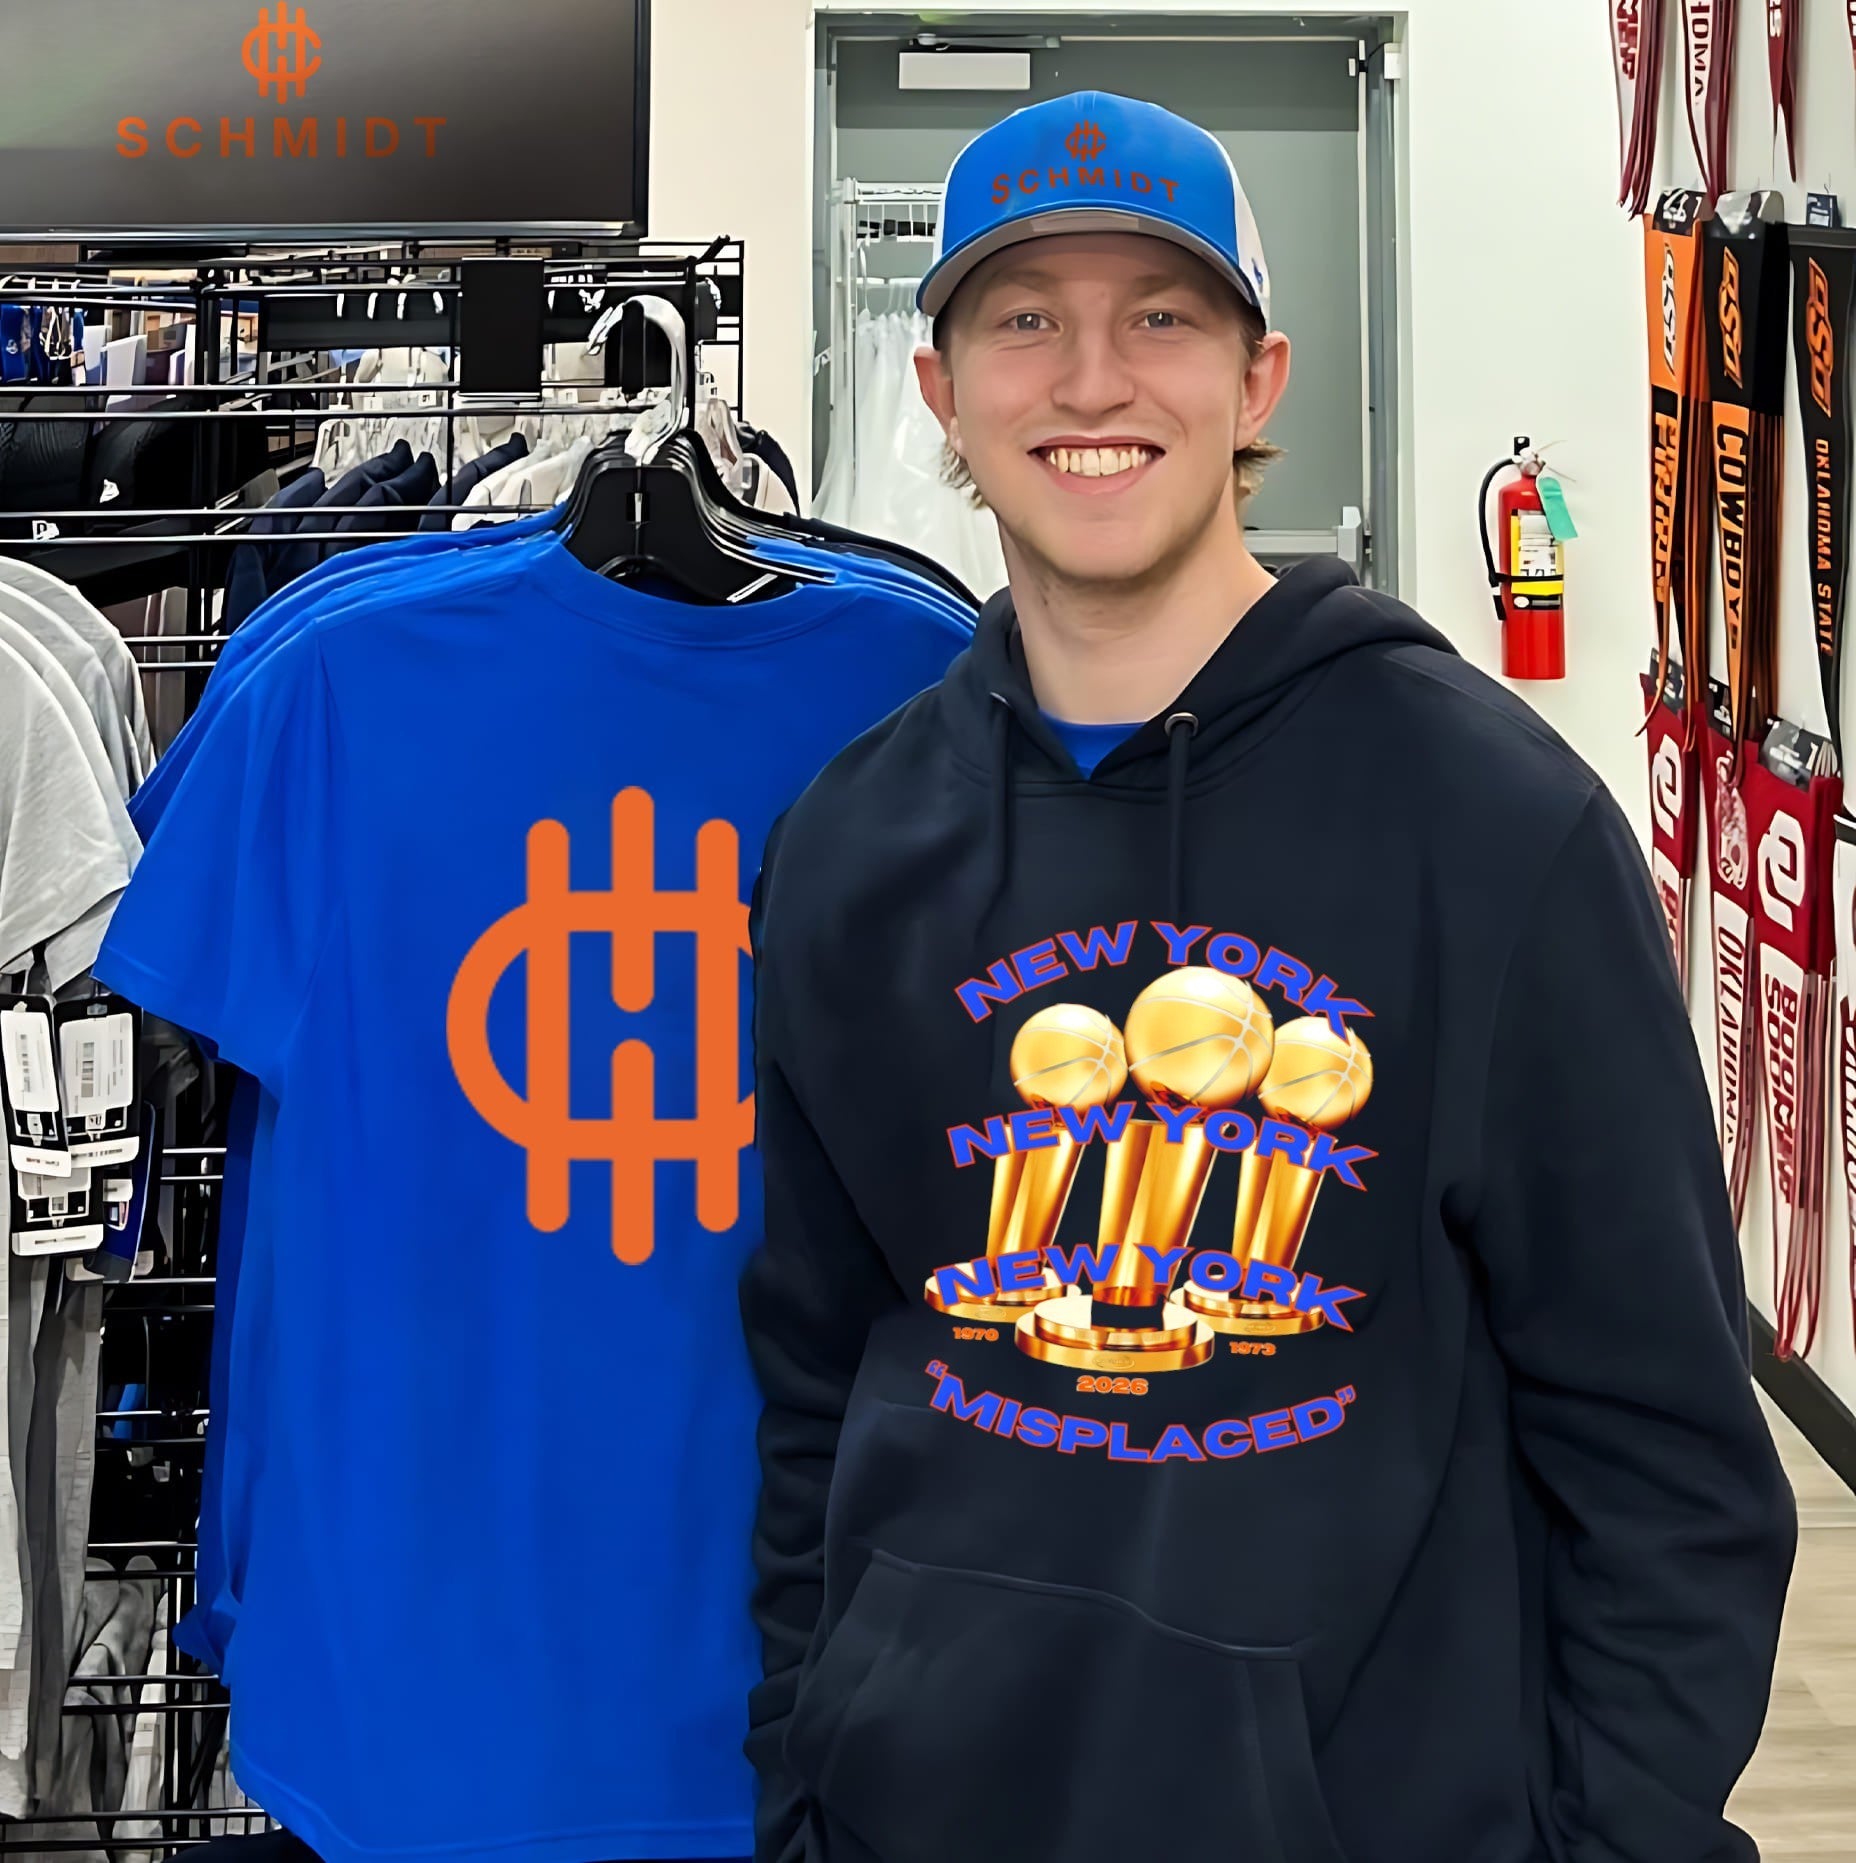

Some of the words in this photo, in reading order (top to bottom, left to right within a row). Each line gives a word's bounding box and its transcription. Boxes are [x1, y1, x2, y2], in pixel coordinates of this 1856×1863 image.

[115, 116, 448, 159] SCHMIDT
[991, 167, 1180, 205] SCHMIDT
[1815, 438, 1833, 570] OKLAHOMA
[954, 919, 1139, 1024] NEW
[1149, 920, 1376, 1042] YORK
[946, 1100, 1137, 1168] NEW
[1146, 1103, 1379, 1192] YORK
[932, 1243, 1121, 1309] NEW
[1134, 1244, 1368, 1334] YORK
[953, 1326, 999, 1342] 1970
[1229, 1341, 1277, 1357] 1973
[1076, 1375, 1149, 1395] 2026
